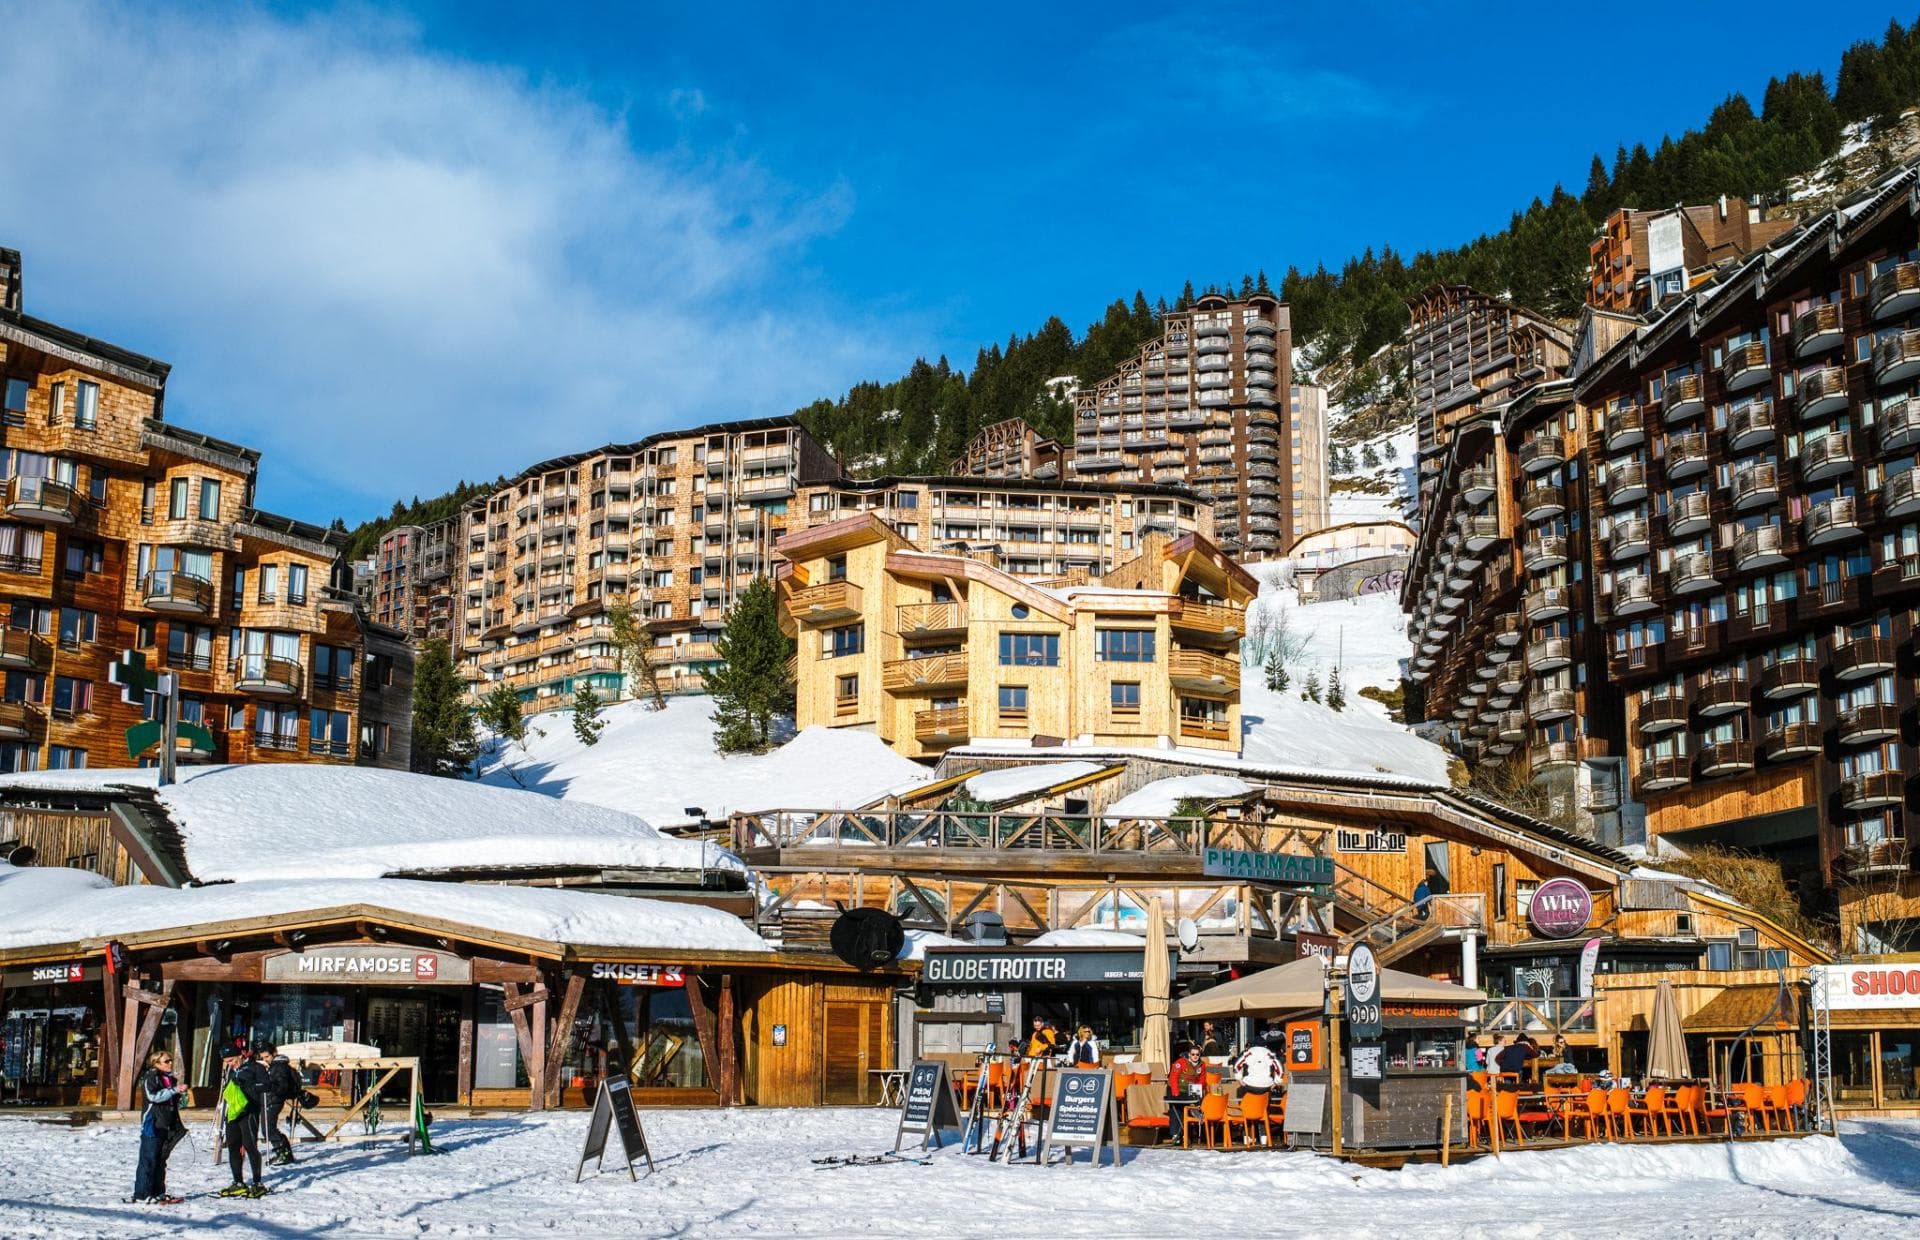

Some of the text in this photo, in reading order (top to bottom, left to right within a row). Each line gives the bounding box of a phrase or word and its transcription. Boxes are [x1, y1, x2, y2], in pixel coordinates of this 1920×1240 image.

[1207, 850, 1332, 873] PHARMACIE
[1541, 894, 1583, 914] Why
[32, 966, 69, 980] SKISET
[299, 957, 412, 973] MIRFAMOSE
[592, 963, 662, 980] SKISET
[928, 958, 1067, 980] GLOBETROTTER
[1064, 1095, 1096, 1105] Burgers
